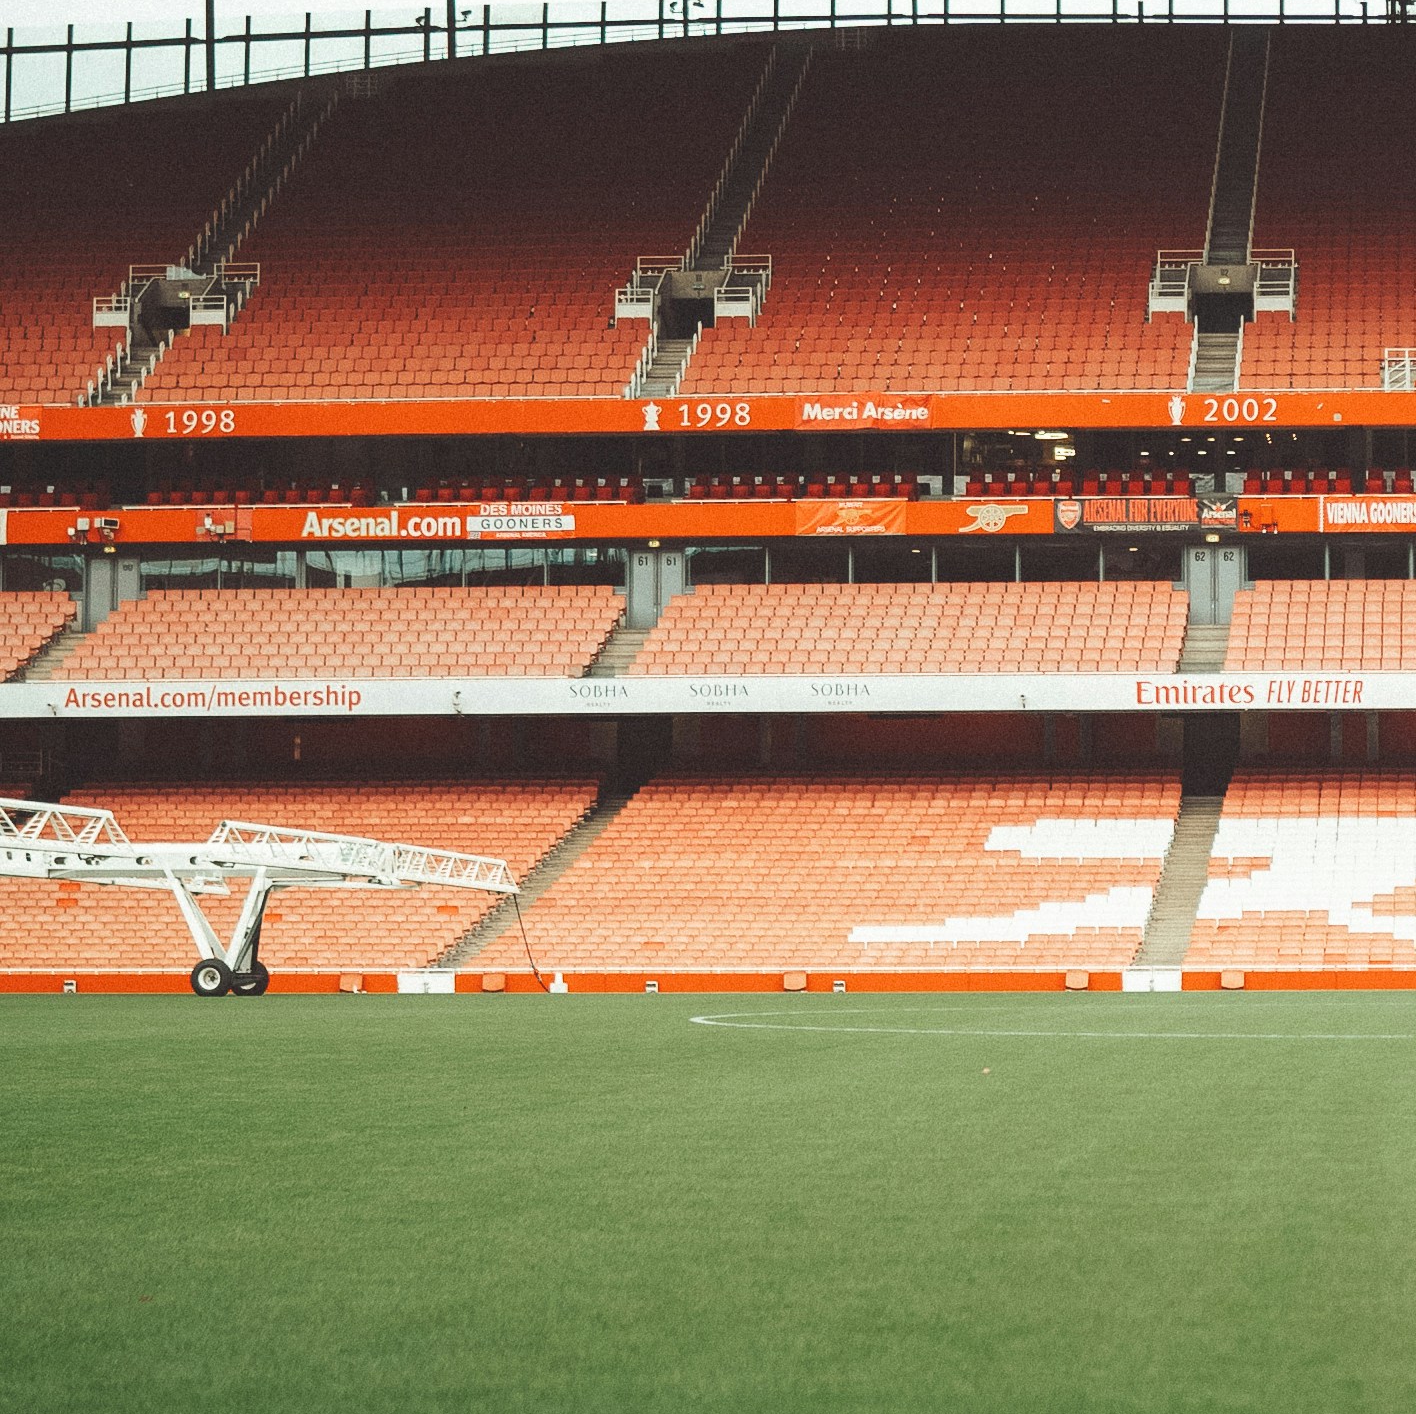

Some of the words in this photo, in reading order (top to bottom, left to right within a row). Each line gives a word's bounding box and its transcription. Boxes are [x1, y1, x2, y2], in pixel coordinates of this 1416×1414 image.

[679, 402, 751, 427] 1998
[802, 402, 858, 421] Merci
[862, 402, 929, 420] Arsène
[1204, 398, 1277, 422] 2002
[164, 409, 236, 434] 1998
[481, 504, 508, 516] DES
[510, 504, 563, 515] MOINES
[1084, 499, 1127, 522] ARSENAL
[1129, 499, 1148, 522] FOR
[1150, 498, 1199, 522] EVERYONE
[1202, 507, 1237, 518] Arsenal
[1326, 502, 1369, 524] VIENNA
[301, 510, 461, 537] Arsenal.com
[481, 518, 563, 530] GOONERS
[638, 555, 649, 566] 61
[666, 555, 677, 566] 61
[1194, 551, 1206, 562] 62
[1223, 551, 1235, 562] 62
[569, 685, 629, 699] SOBHA
[689, 683, 749, 698] SOBHA
[811, 683, 870, 697] SOBHA
[1136, 680, 1255, 705] Emirates
[1267, 680, 1296, 704] FLY
[1301, 680, 1364, 704] BETTER
[64, 685, 362, 712] Arsenal.com/membership
